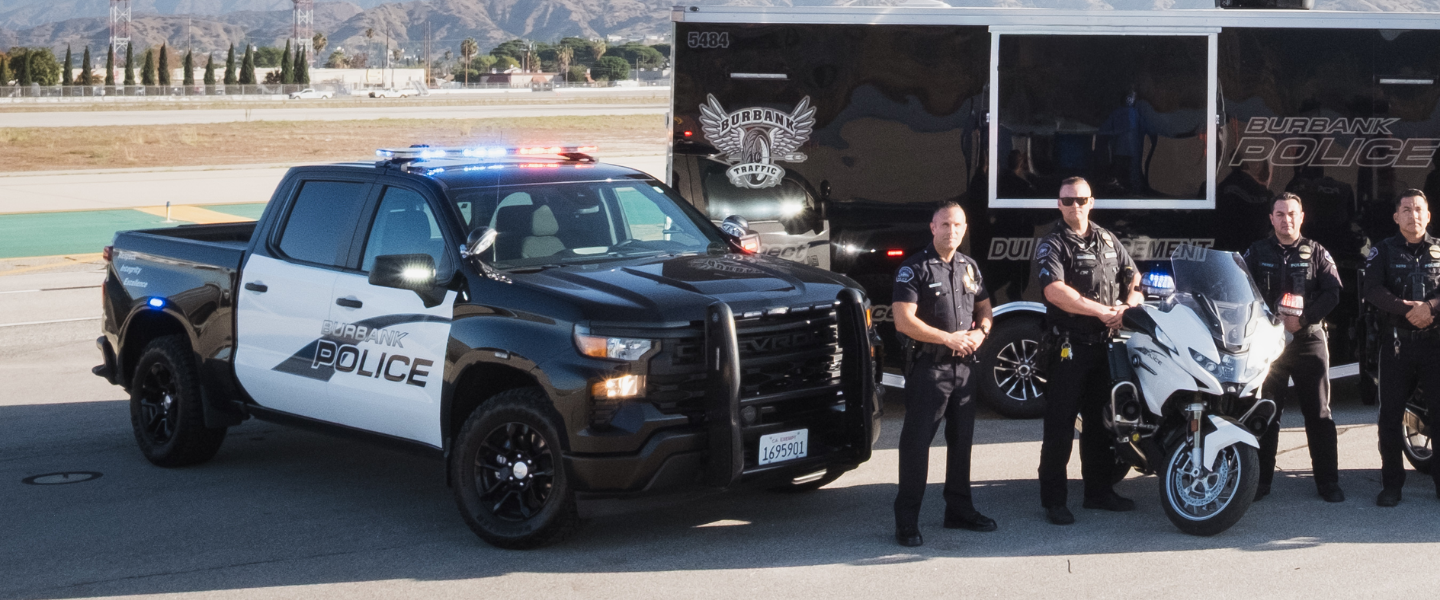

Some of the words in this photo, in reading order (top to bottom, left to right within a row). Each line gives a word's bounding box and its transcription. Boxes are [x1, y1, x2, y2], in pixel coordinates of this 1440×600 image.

[688, 32, 729, 48] 5484
[721, 109, 796, 133] BURBANK
[1244, 117, 1401, 134] BURBANK
[734, 165, 778, 175] TRAFFIC
[988, 237, 1034, 260] DUI
[321, 320, 409, 348] BURBANK
[311, 339, 434, 388] POLICE
[762, 440, 804, 461] 1695901
